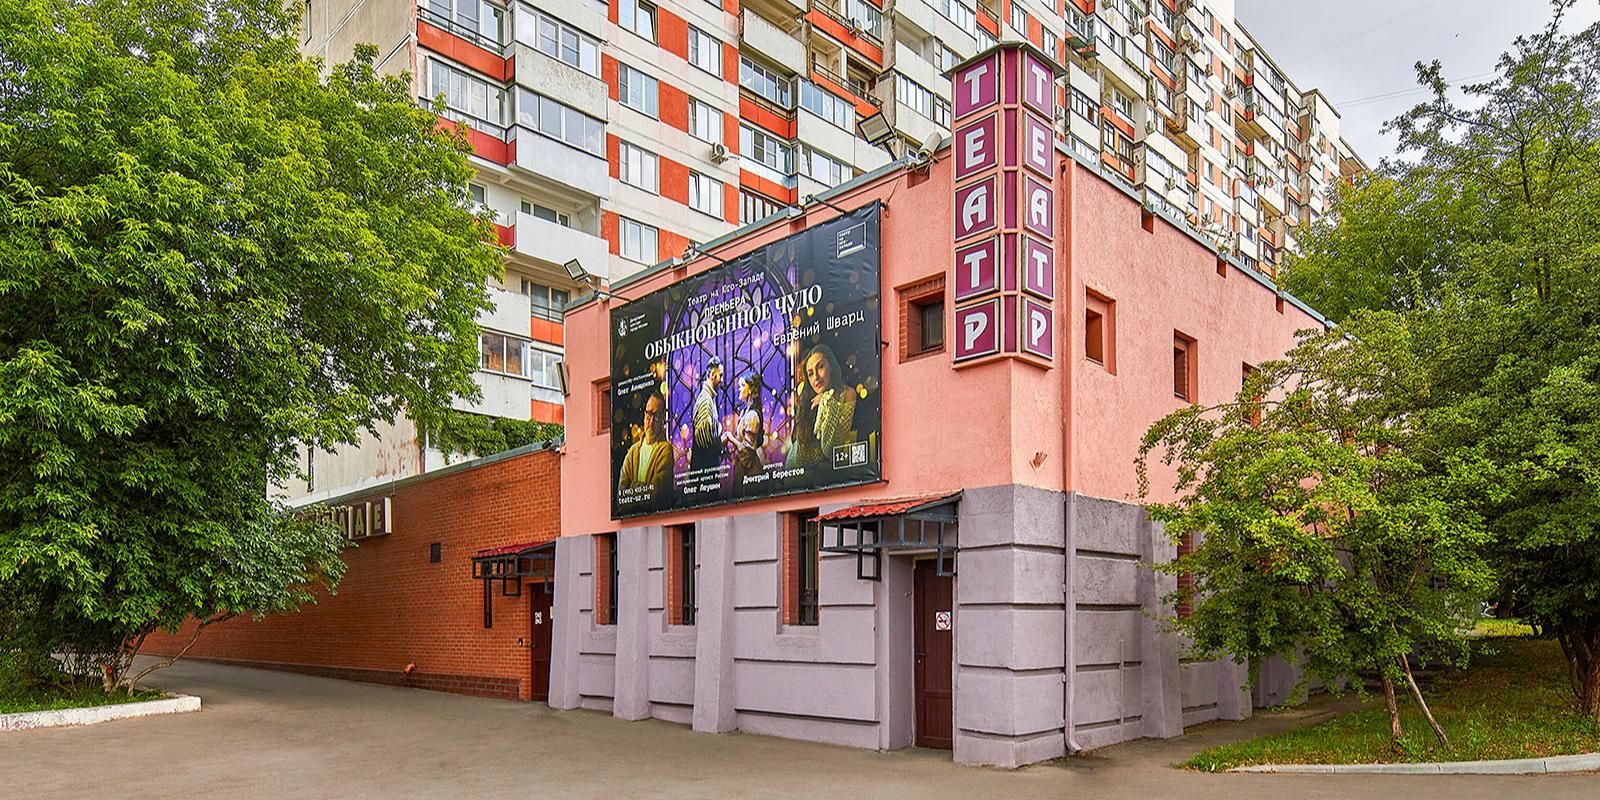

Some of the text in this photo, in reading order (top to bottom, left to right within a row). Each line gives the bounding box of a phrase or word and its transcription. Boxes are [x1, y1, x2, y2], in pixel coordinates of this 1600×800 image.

[961, 63, 988, 351] ТЕАТР
[1030, 62, 1049, 347] ТЕАТР
[687, 271, 765, 307] Театр на Юго-Западе
[704, 294, 746, 318] ПРЕМЬЕРА
[644, 302, 772, 360] ОБЫКНОВЕННОЕ
[775, 284, 823, 316] ЧУДО
[773, 309, 865, 347] Евгений Шварц
[835, 451, 849, 462] 12+
[683, 486, 698, 494] Олег
[742, 467, 805, 485] Дмитрий Берестов
